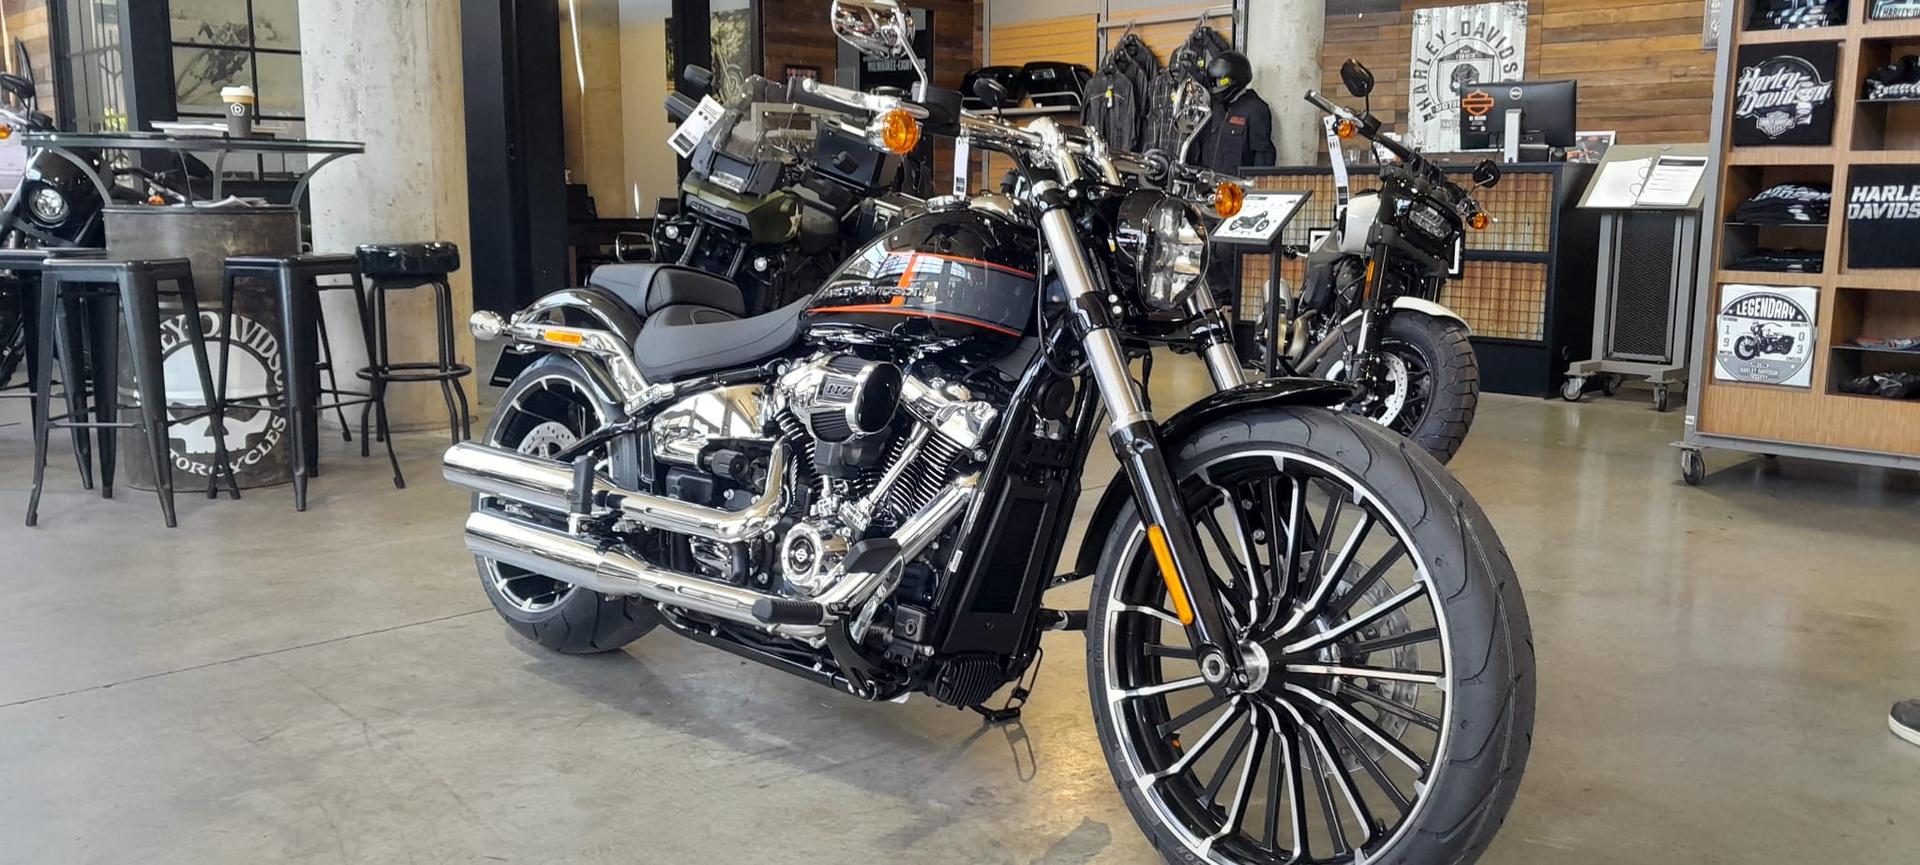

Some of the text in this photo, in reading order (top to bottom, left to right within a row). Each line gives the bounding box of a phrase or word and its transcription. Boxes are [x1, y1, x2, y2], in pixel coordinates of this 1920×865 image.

[1412, 20, 1519, 112] HARLEY-DAVIDS
[1736, 297, 1796, 320] LEGENDARY
[170, 415, 287, 478] TORCYCLES
